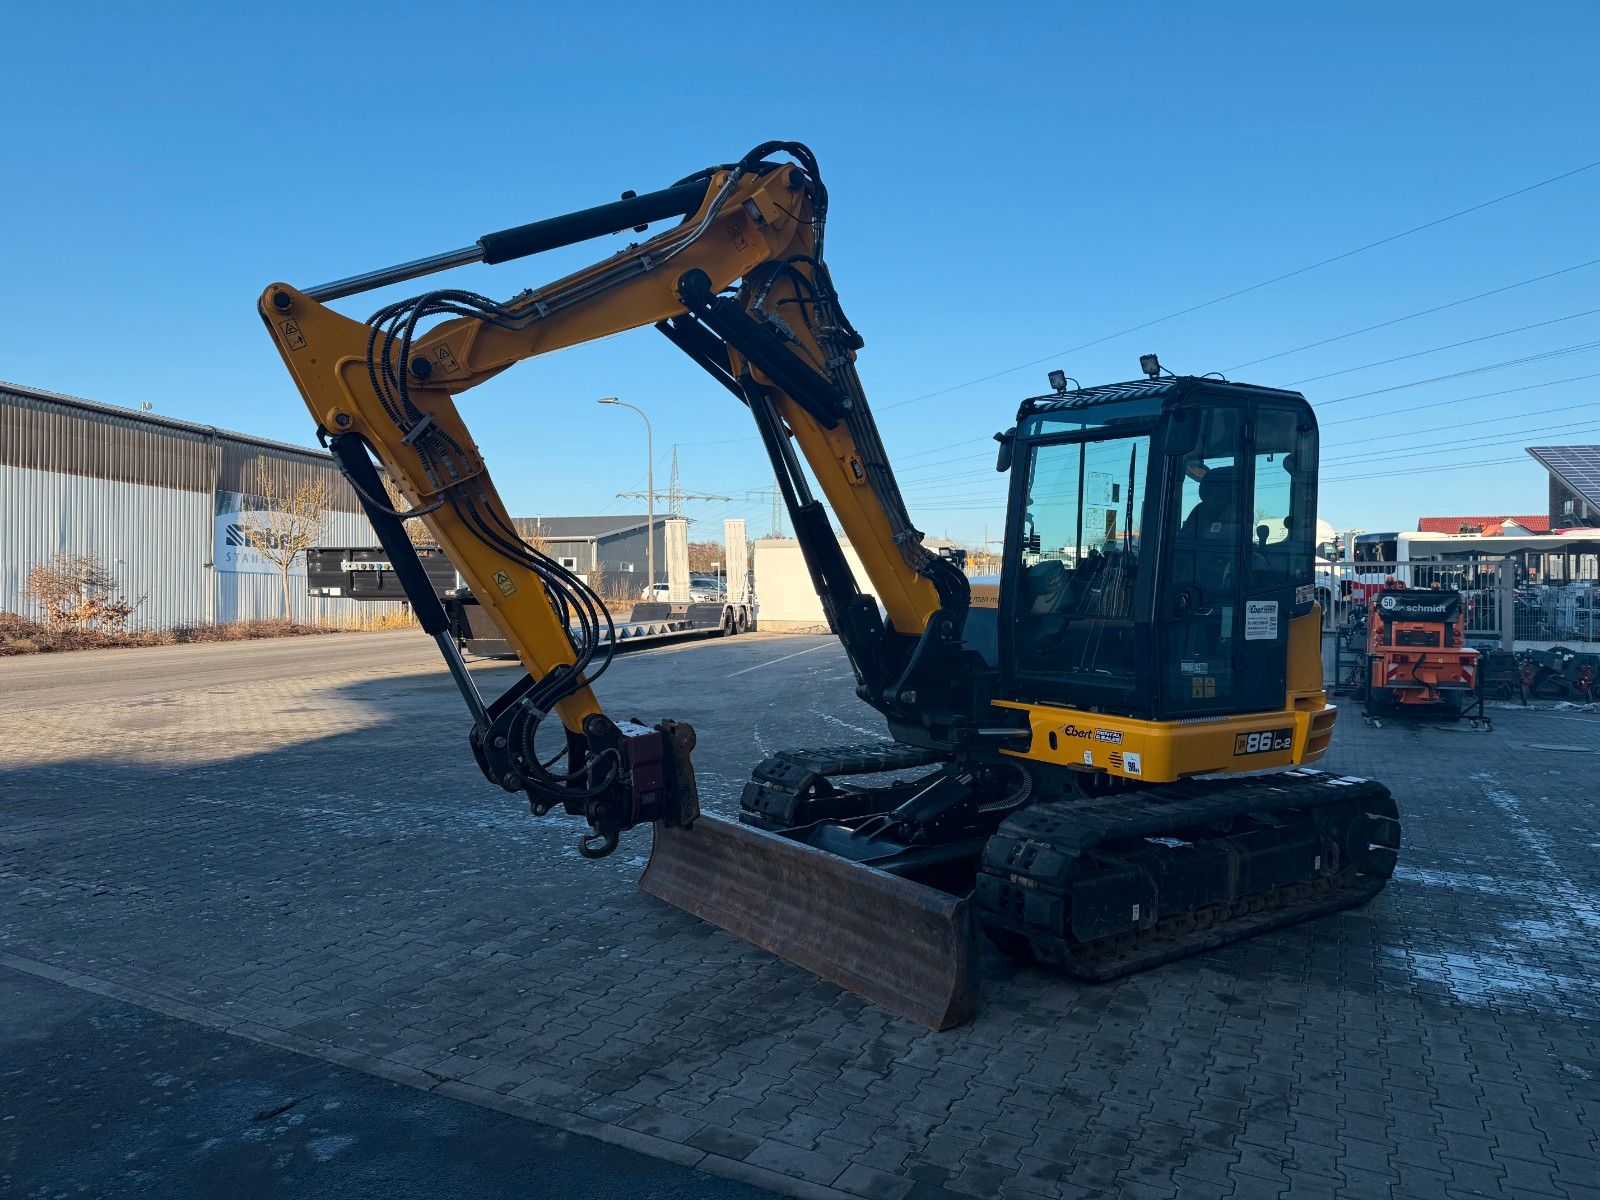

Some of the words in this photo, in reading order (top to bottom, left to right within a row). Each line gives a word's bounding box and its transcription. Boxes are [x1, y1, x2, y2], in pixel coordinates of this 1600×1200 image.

[1383, 599, 1393, 607] 50
[1406, 605, 1447, 613] schmidt
[1064, 725, 1093, 740] Ebert
[1246, 732, 1273, 753] 86
